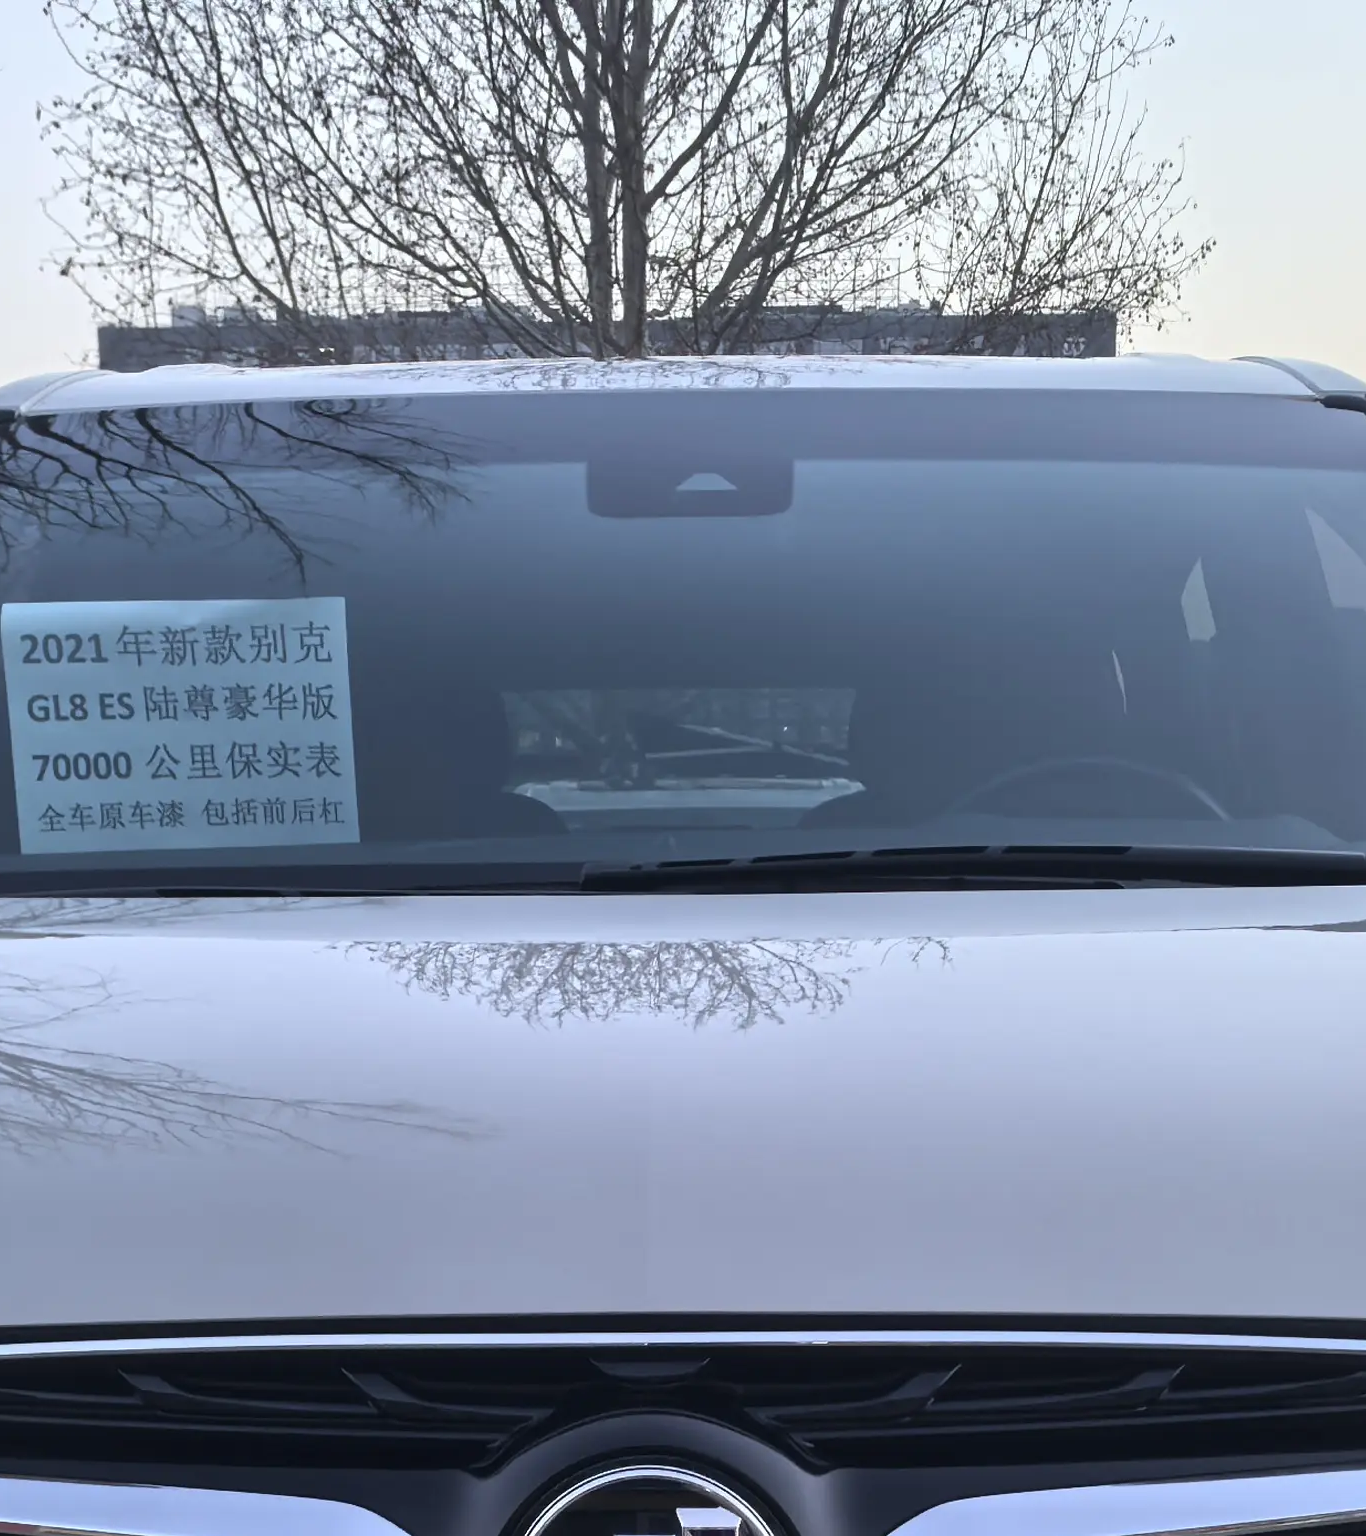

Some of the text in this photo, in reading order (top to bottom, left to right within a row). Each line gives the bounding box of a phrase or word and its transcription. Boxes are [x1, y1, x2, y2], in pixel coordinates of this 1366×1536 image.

[21, 622, 333, 667] 2021 年新款别克
[27, 683, 338, 722] GL8 ES 陆尊豪华版
[32, 741, 341, 782] 70000 公里保实表
[39, 797, 345, 832] 全车原车漆 包括前后杠
